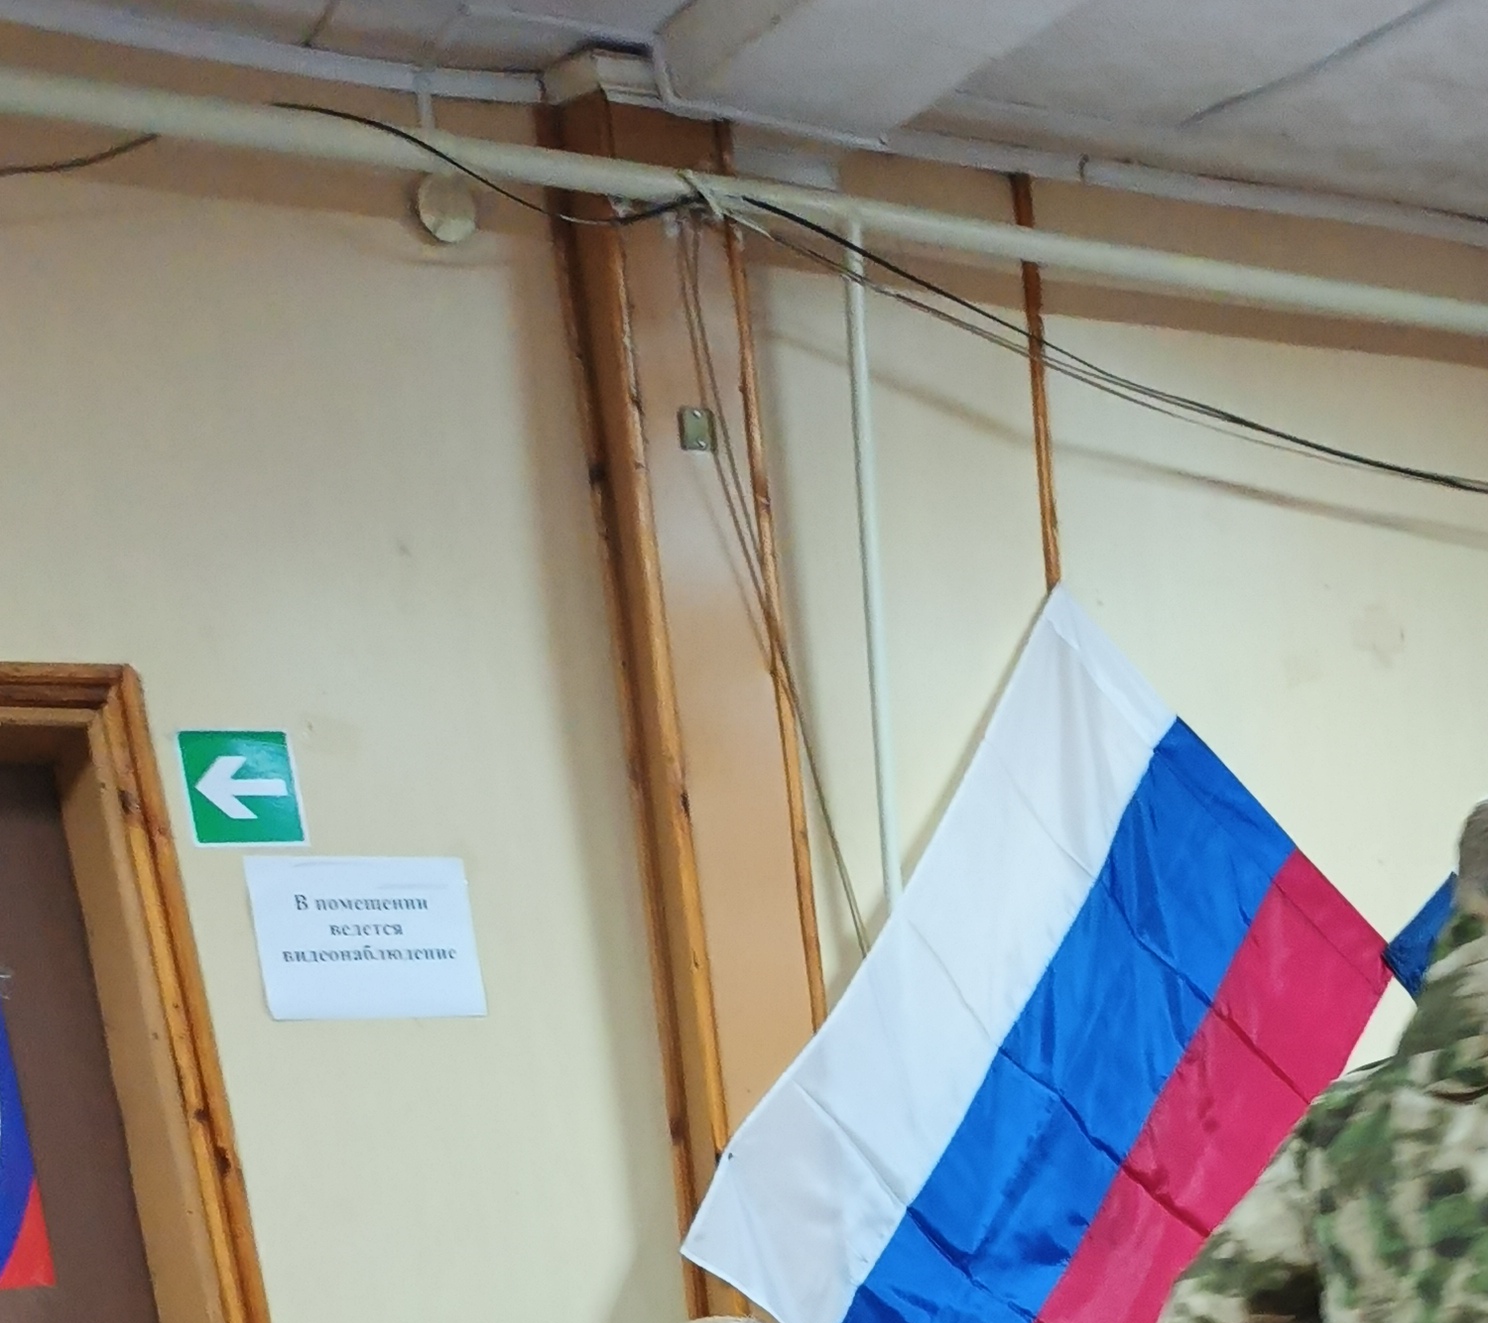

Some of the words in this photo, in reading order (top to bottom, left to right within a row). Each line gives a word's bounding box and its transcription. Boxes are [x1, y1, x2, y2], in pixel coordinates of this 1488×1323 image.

[294, 894, 309, 911] В
[315, 898, 429, 912] помещении
[329, 922, 404, 937] ведется
[282, 945, 458, 963] видеонаблюдение
